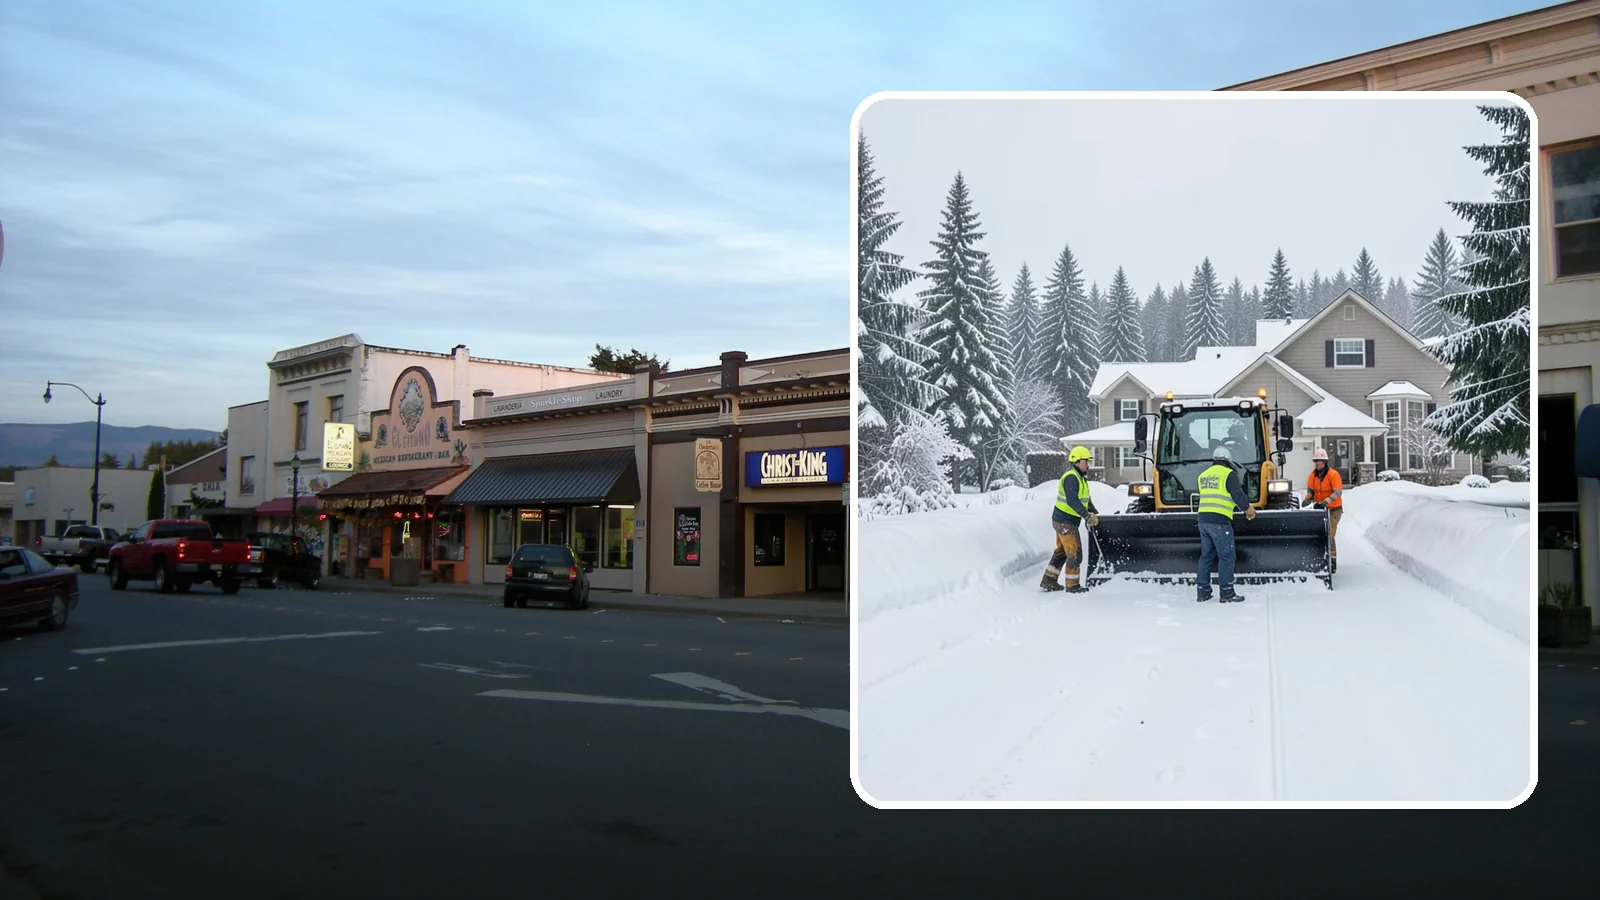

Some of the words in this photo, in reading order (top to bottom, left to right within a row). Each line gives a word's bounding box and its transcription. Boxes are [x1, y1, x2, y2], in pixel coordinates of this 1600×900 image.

[596, 389, 623, 399] LAUNDRY
[494, 402, 523, 412] LAVANDERIA
[531, 397, 561, 409] Sparkle
[561, 394, 582, 405] Shop
[374, 455, 396, 464] MEXICAN
[398, 452, 433, 462] RESTAURANT
[438, 450, 450, 458] BAR
[761, 452, 797, 478] CHRIST
[799, 450, 827, 476] KING
[697, 481, 709, 489] Coffee
[710, 481, 722, 489] House
